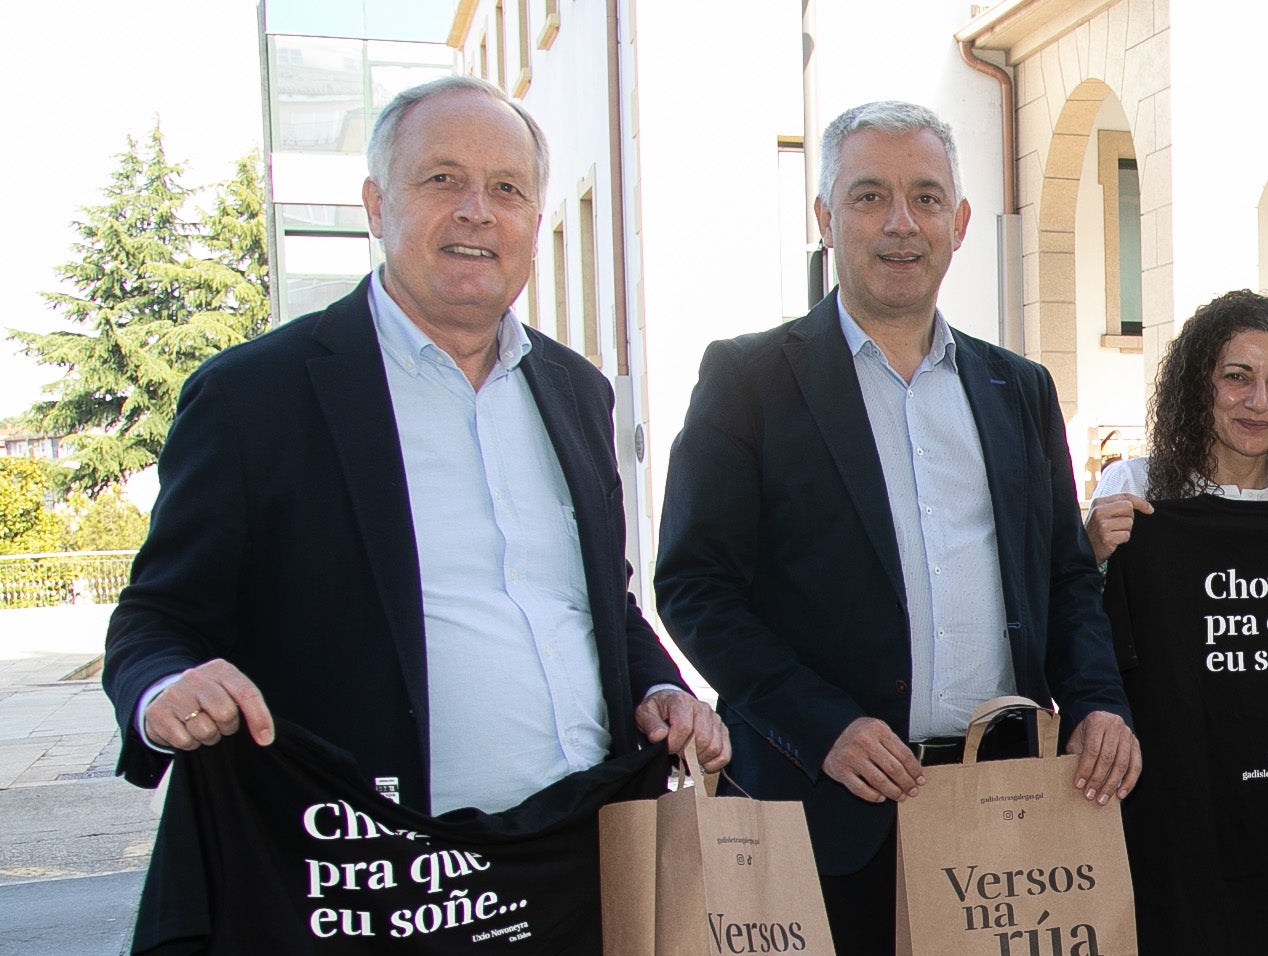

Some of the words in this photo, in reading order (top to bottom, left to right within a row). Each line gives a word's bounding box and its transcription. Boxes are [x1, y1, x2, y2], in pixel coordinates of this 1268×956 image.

[1204, 615, 1259, 644] pra
[1207, 652, 1246, 671] eu
[305, 859, 397, 897] pra
[410, 849, 492, 894] que
[940, 862, 1097, 904] Versos
[311, 908, 375, 937] eu
[390, 889, 528, 938] soñe...
[708, 913, 806, 954] Versos
[962, 902, 1020, 931] na
